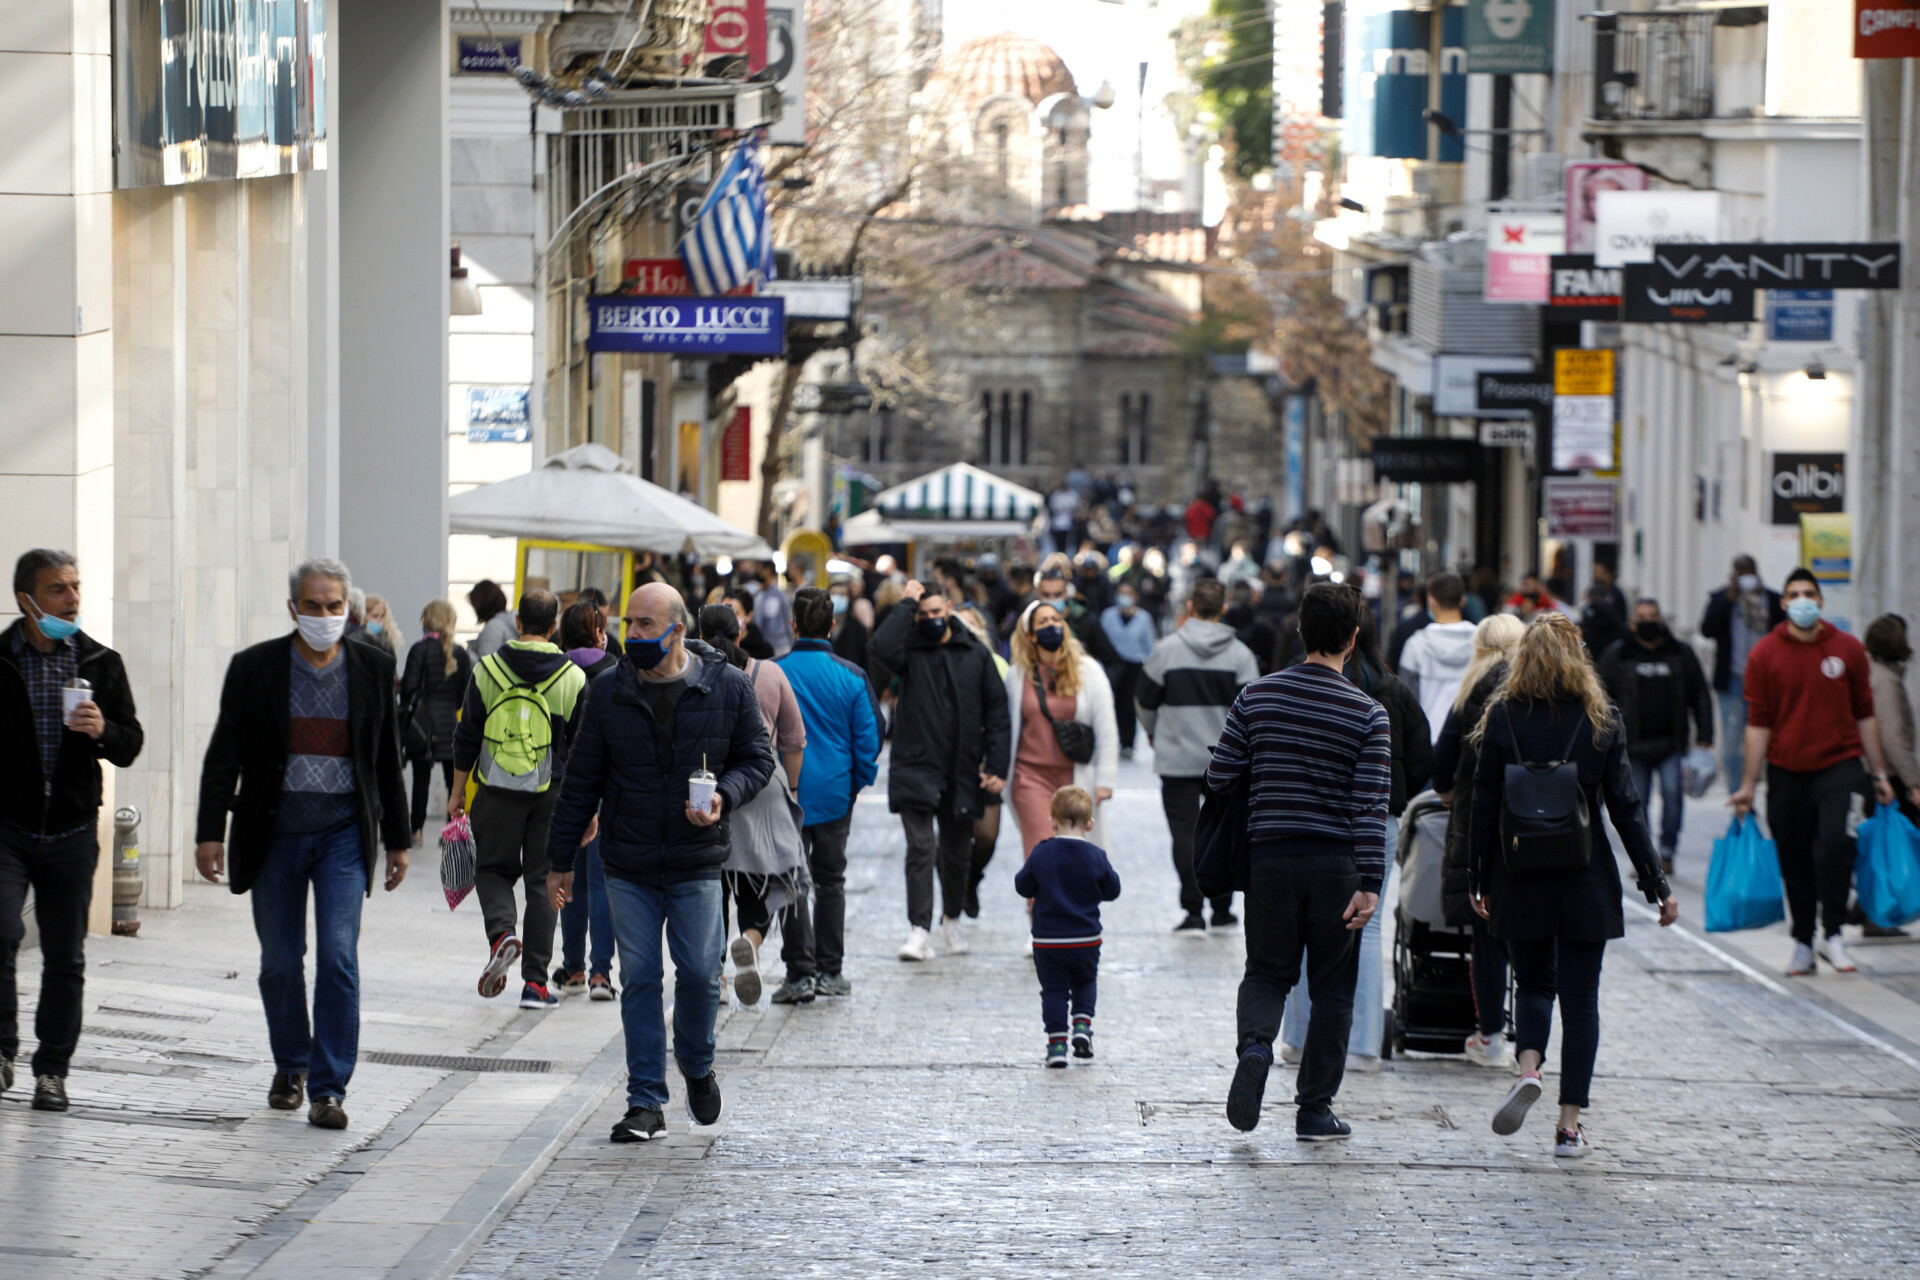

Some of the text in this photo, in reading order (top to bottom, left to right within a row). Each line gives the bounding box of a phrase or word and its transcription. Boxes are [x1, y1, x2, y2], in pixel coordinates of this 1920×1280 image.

[1657, 253, 1897, 280] VANITY
[598, 305, 771, 328] BERTO LUCCI
[642, 333, 727, 344] MILANO
[1773, 462, 1843, 499] alibi
